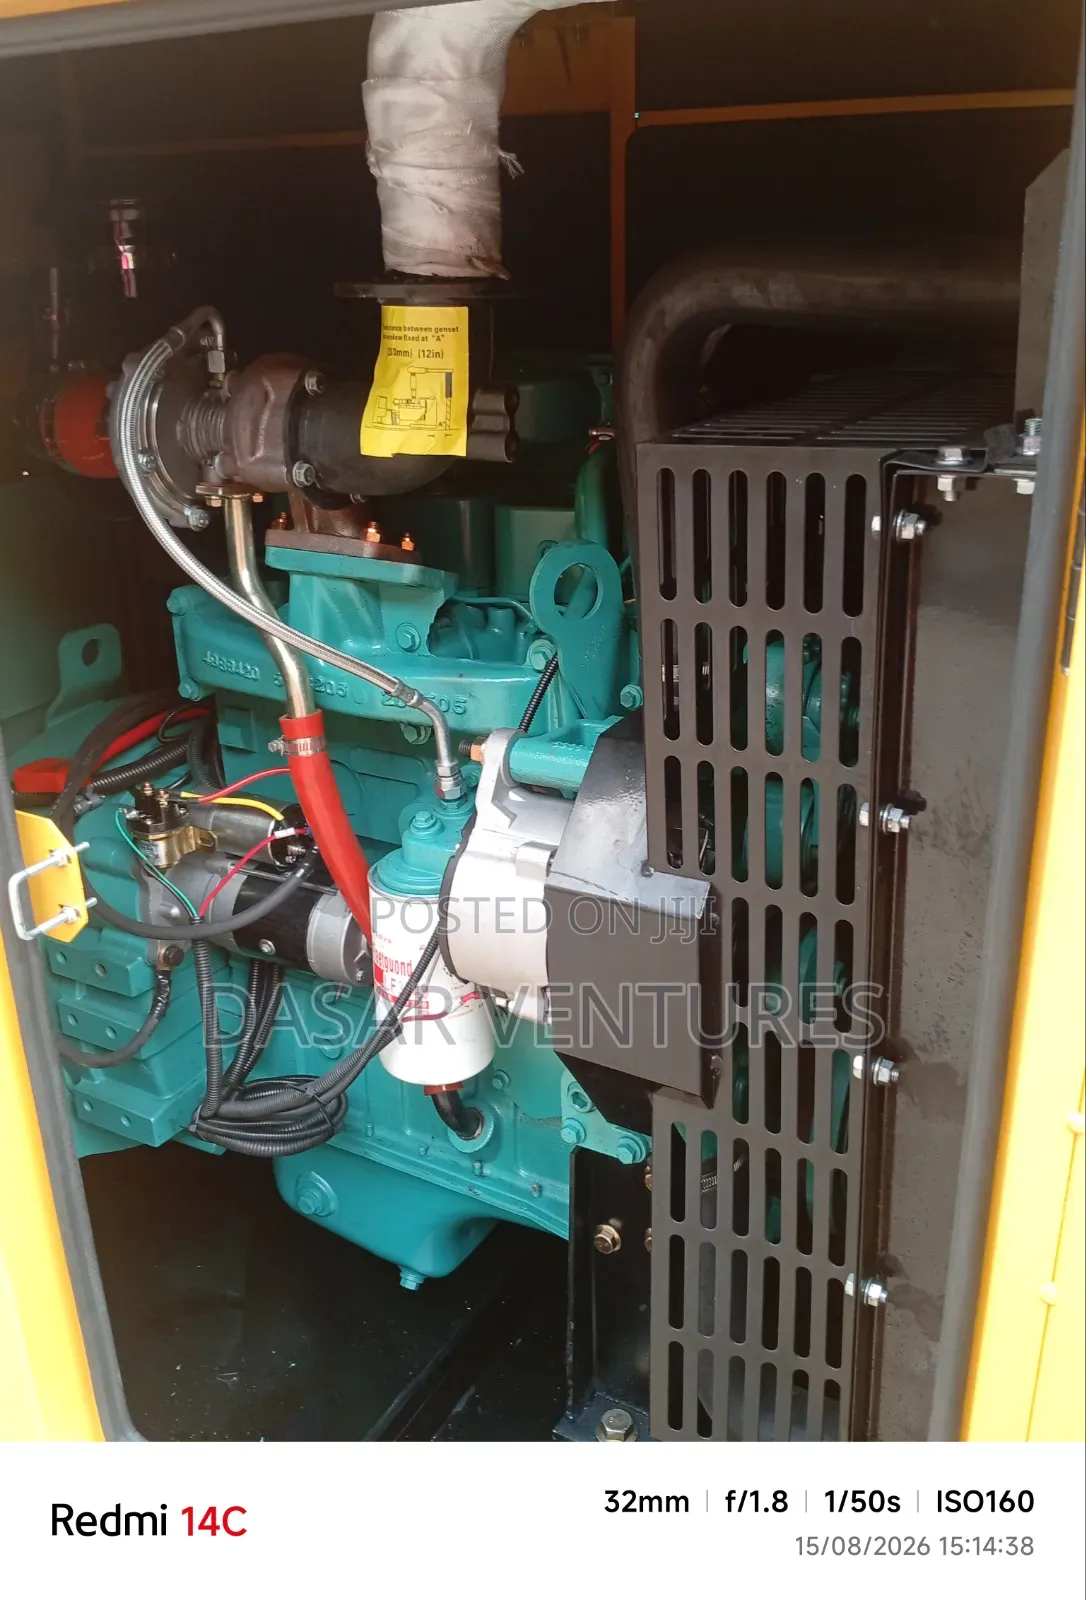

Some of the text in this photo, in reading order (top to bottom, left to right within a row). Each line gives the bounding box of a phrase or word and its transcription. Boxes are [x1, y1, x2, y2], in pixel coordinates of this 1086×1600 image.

[403, 325, 433, 333] between
[404, 334, 420, 342] fixed
[418, 349, 444, 359] (12in)
